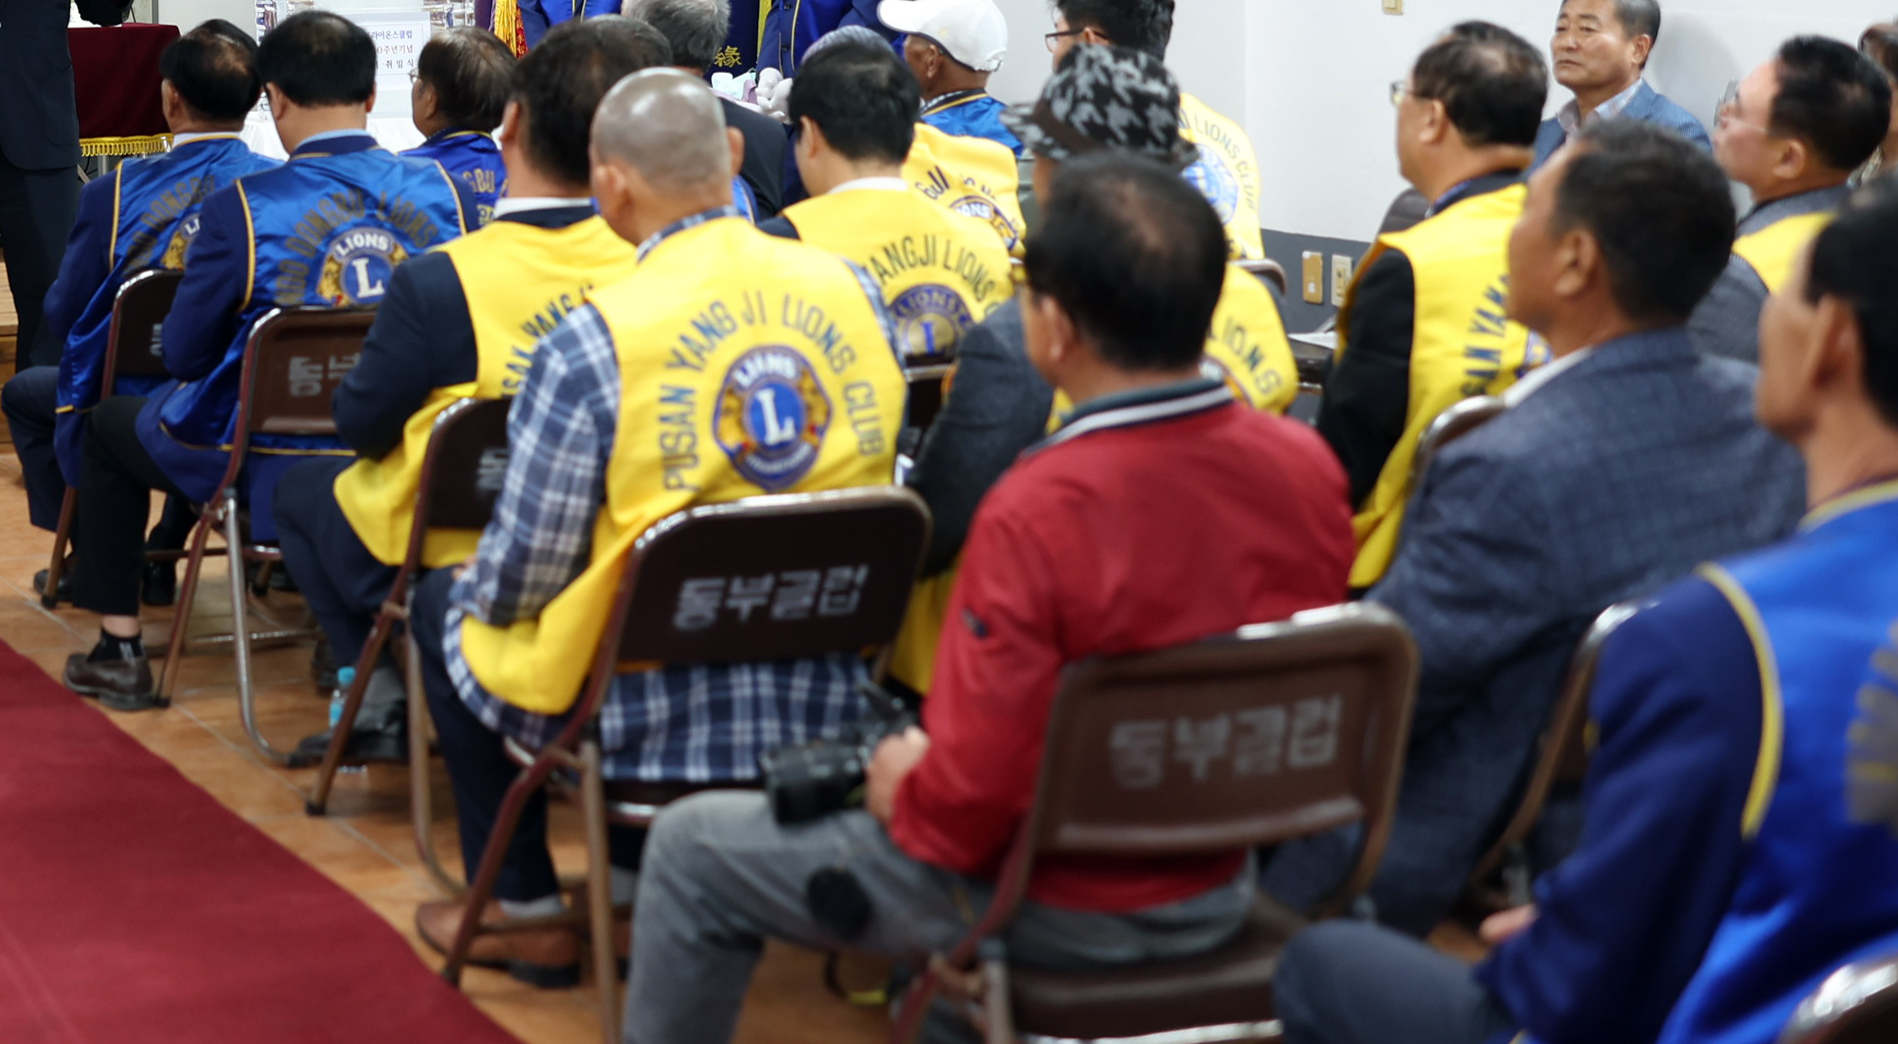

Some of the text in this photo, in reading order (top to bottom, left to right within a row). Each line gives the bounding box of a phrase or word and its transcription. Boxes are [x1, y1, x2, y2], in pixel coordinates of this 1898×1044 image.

[1193, 112, 1241, 160] LIONS
[335, 231, 390, 257] LIONS
[352, 257, 386, 298] L
[943, 239, 996, 303] LIONS
[665, 300, 738, 374] YANG
[781, 293, 858, 375] LIONS
[657, 384, 701, 493] PUSAN
[755, 387, 796, 446] L
[843, 380, 886, 456] CLUB
[673, 564, 870, 631] 동부클럽
[1110, 694, 1344, 787] 동부클럽
